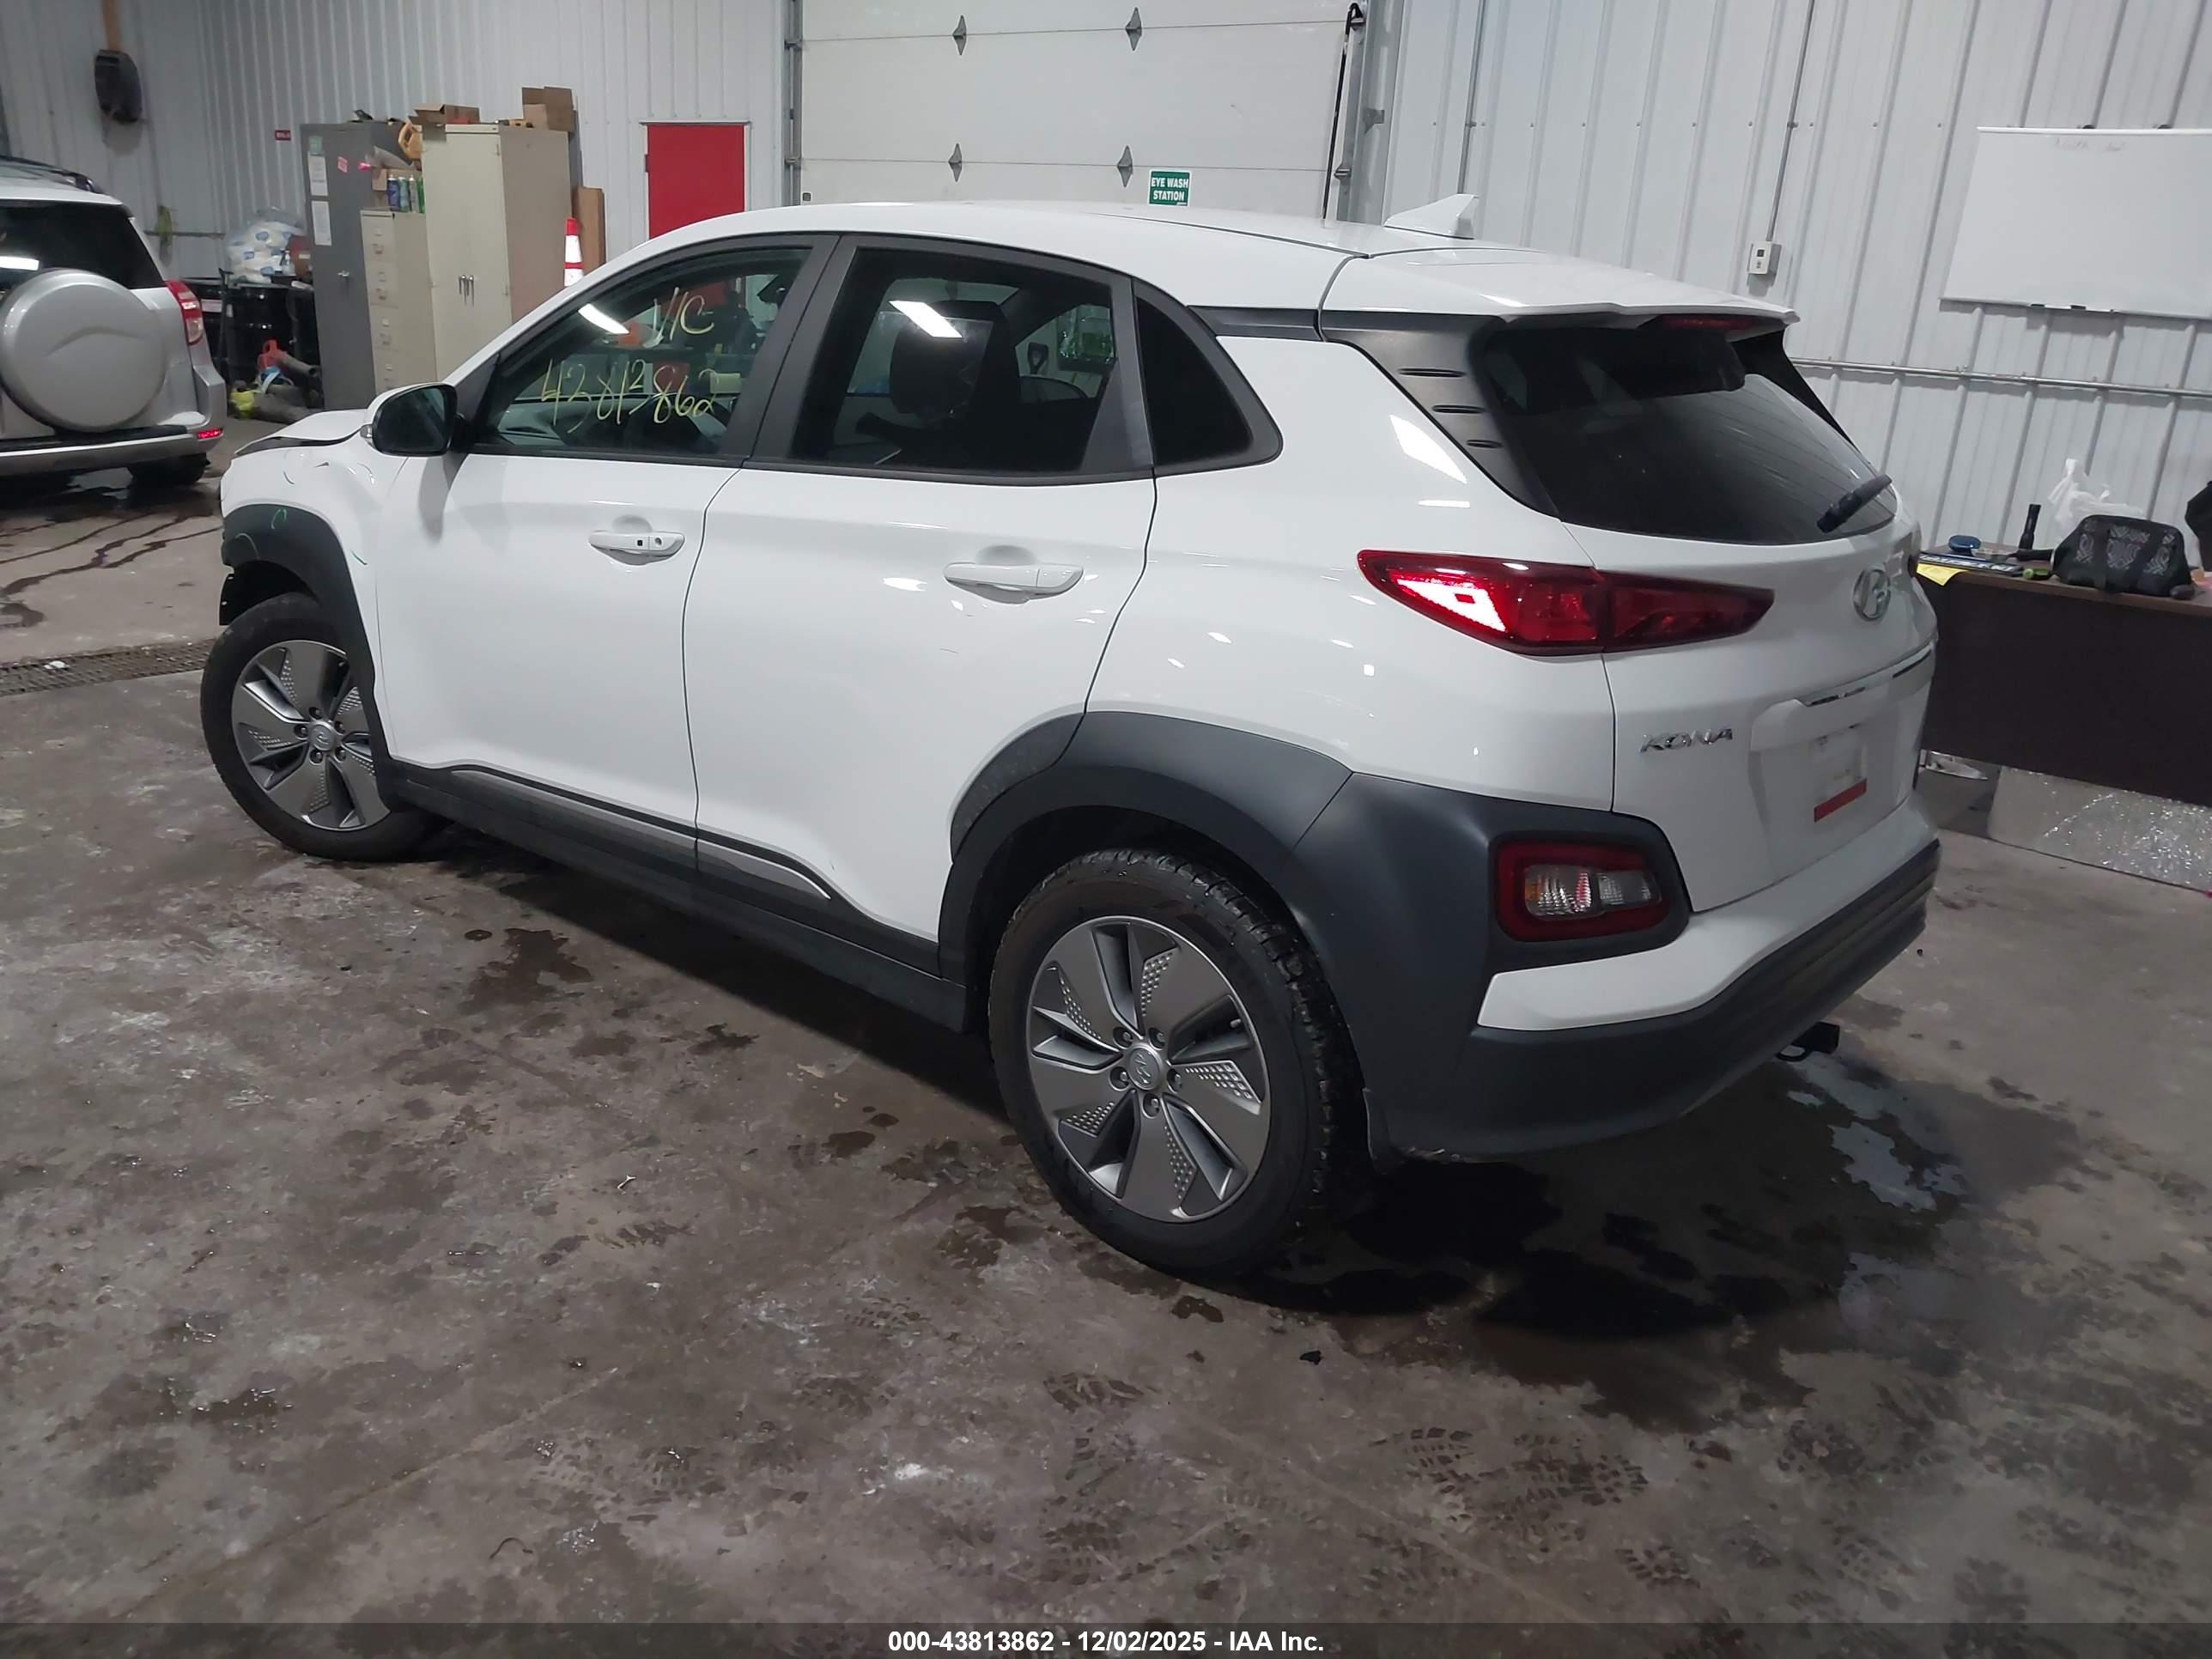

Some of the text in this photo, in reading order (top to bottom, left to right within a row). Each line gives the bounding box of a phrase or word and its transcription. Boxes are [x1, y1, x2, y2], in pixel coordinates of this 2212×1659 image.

[1152, 177, 1189, 189] EYE WASH
[1152, 190, 1185, 201] STATION
[1639, 727, 1733, 754] KONA
